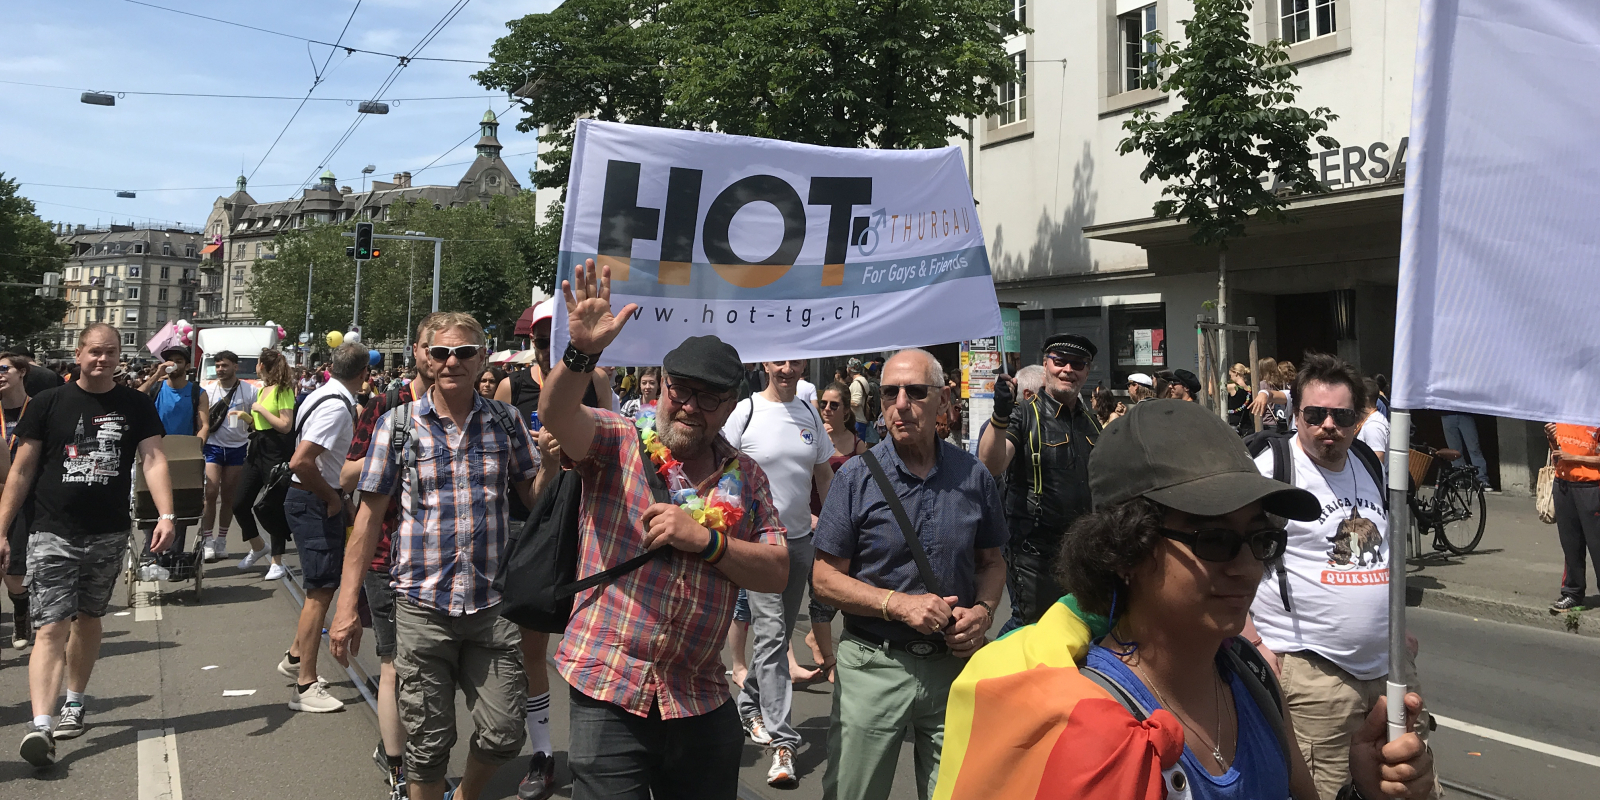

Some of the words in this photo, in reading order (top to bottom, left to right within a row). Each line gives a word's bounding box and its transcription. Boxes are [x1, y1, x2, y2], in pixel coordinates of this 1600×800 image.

[597, 159, 873, 289] HOT
[890, 207, 970, 244] THURGAU
[862, 266, 886, 285] For
[888, 263, 916, 284] Gays
[918, 260, 927, 277] &
[929, 254, 968, 276] Friends
[609, 301, 860, 327] w.hot-tg.ch
[1318, 497, 1352, 526] AFRICA
